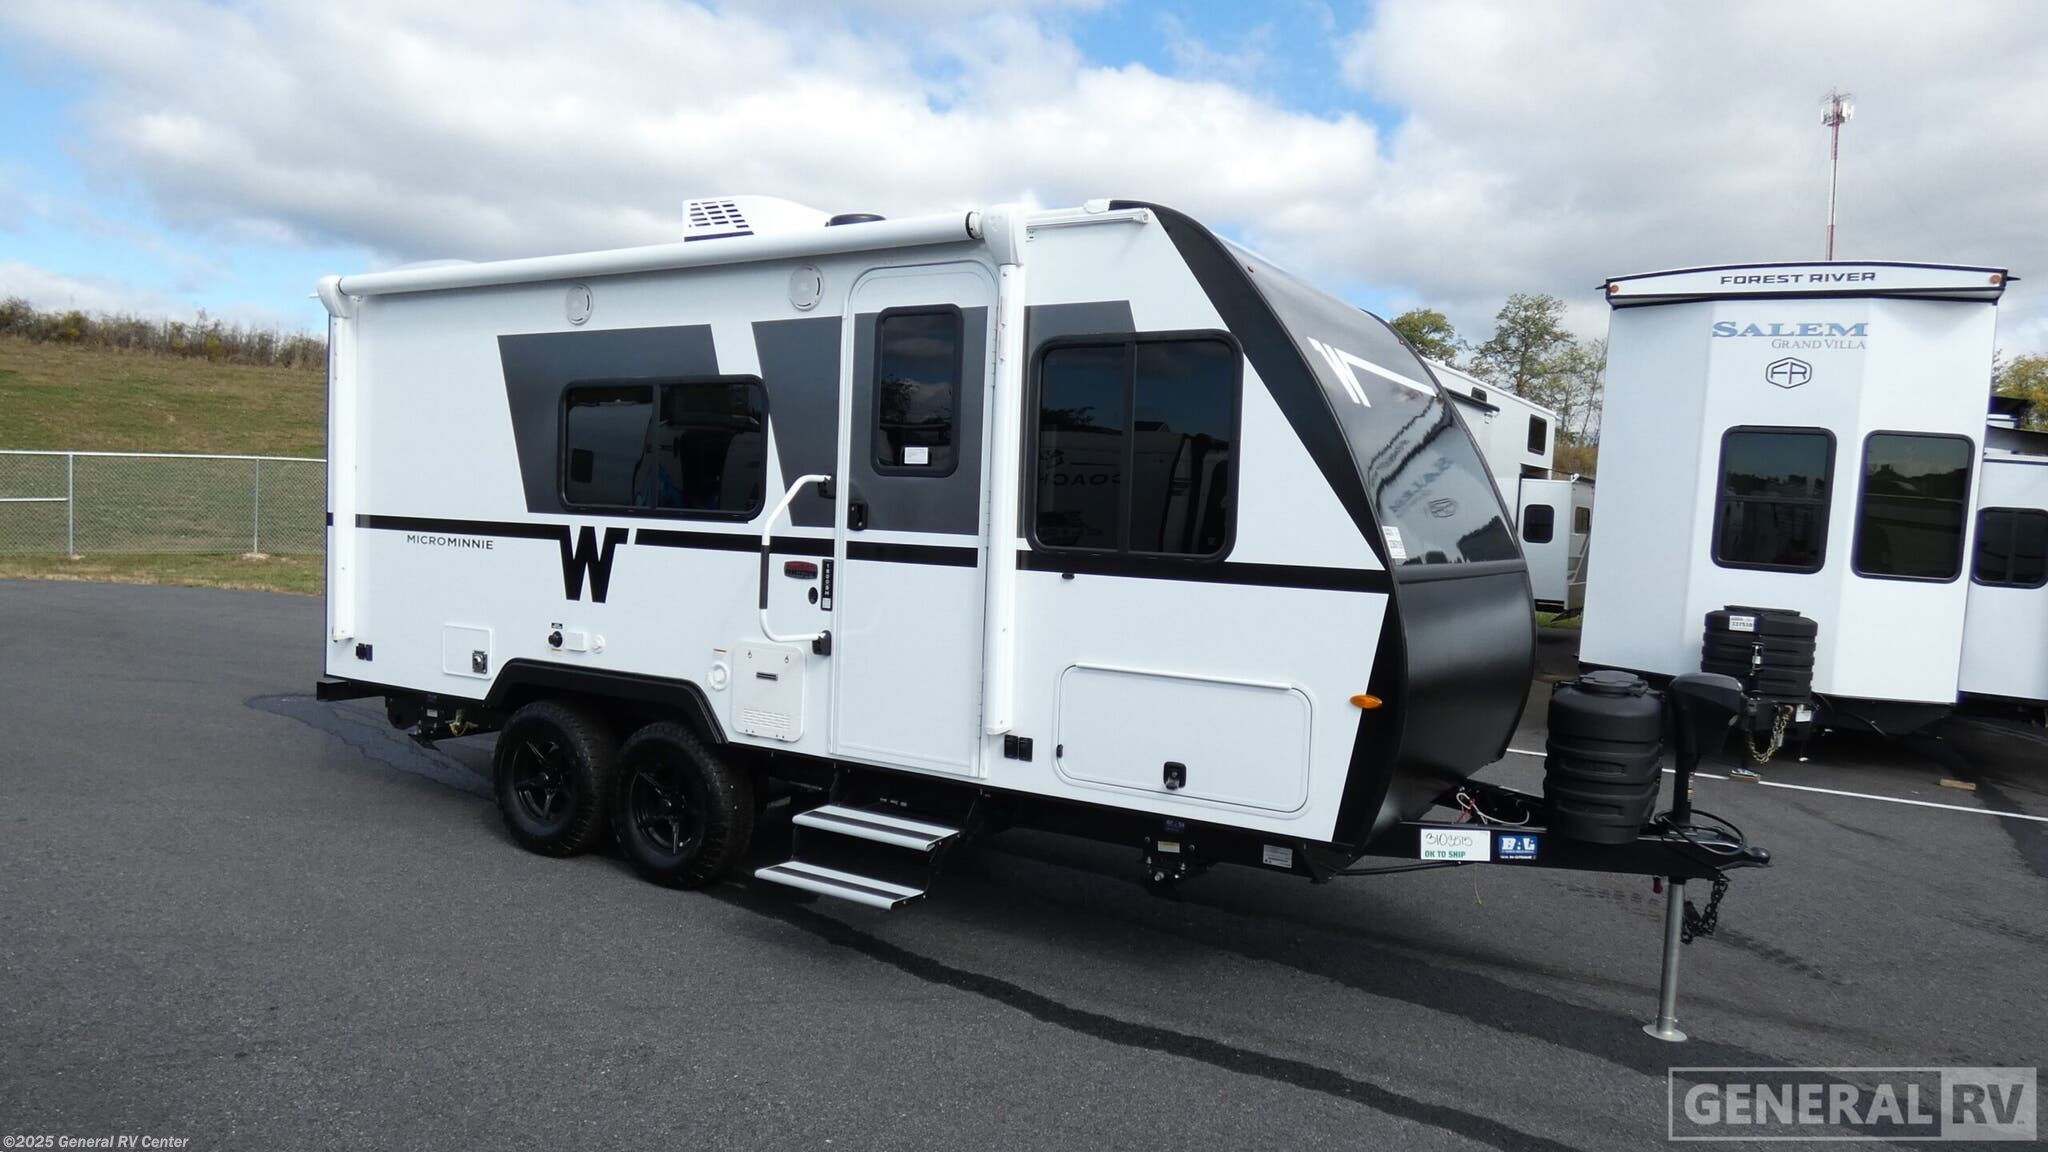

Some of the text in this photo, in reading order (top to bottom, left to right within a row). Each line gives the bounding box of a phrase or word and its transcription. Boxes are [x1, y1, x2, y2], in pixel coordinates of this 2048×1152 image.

[1720, 272, 1876, 285] FOREST RIVER
[1712, 321, 1869, 338] SALEM
[1771, 338, 1866, 350] GRAND VILLA
[406, 534, 494, 550] MICROMINNIE
[1424, 850, 1466, 859] OK TO SHIP
